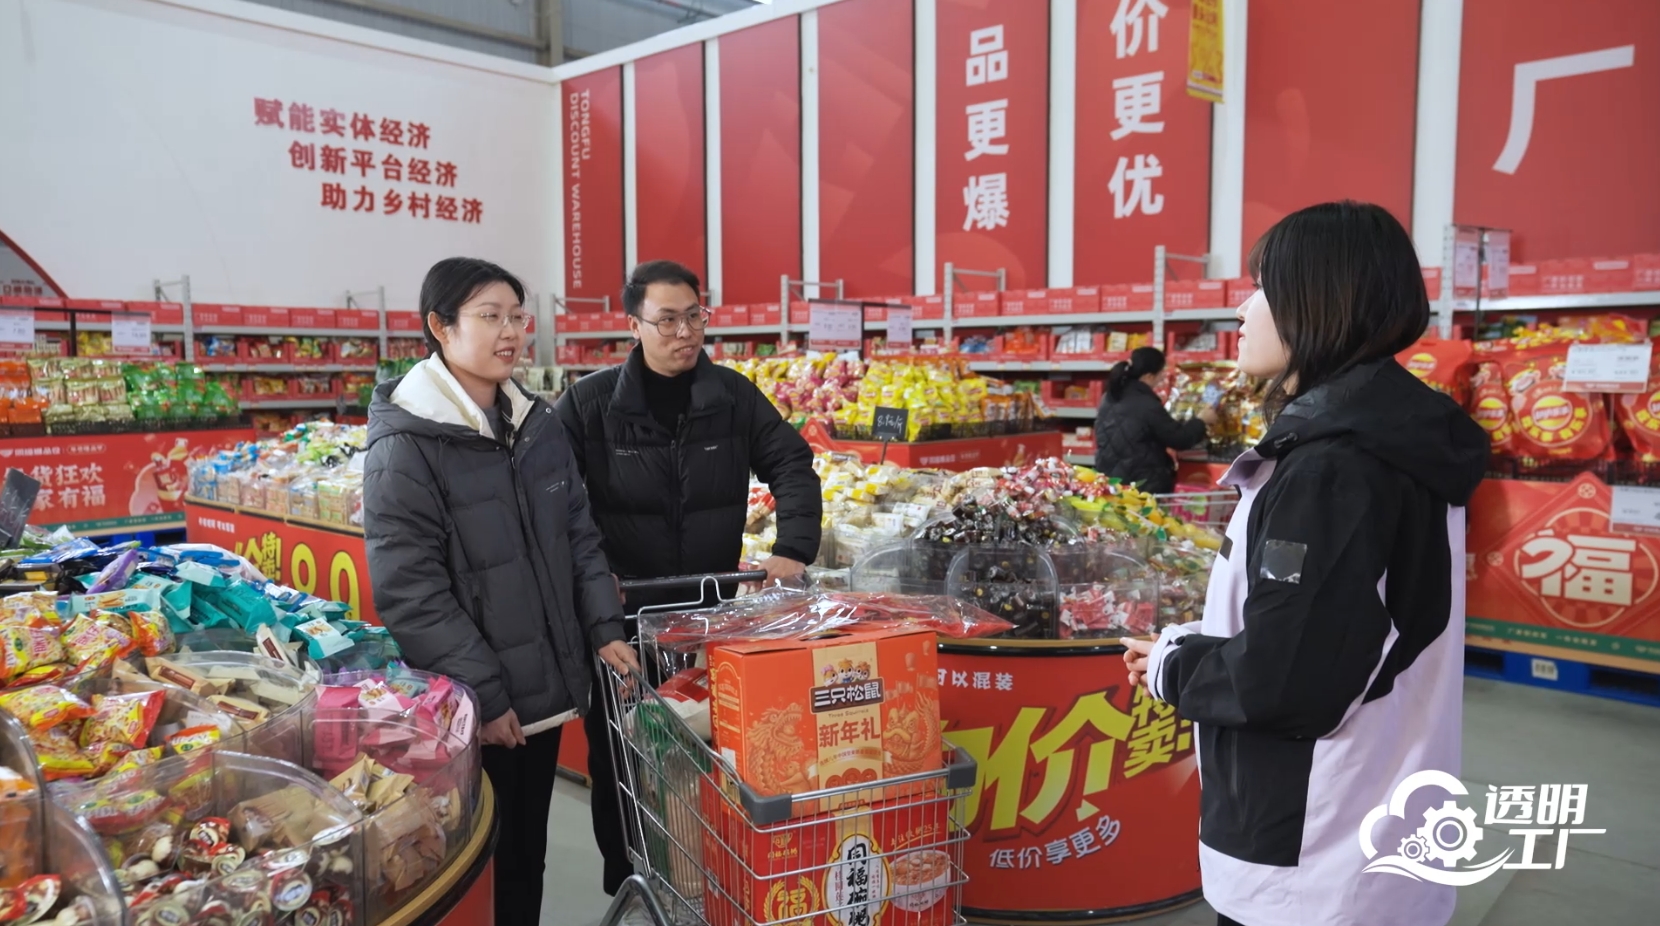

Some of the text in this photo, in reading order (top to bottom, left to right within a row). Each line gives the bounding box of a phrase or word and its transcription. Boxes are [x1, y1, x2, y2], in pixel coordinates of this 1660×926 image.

[254, 97, 431, 149] 赋能实体经济
[580, 89, 590, 160] TONGFU
[963, 24, 1010, 231] 品更爆
[1107, 0, 1169, 219] 价更优
[1491, 44, 1635, 175] 厂
[288, 140, 458, 188] 创新平台经济
[321, 182, 483, 224] 助力乡村经济
[570, 93, 582, 289] DISCOUNT WAREHOUSE
[4, 462, 104, 487] 货狂欢
[1521, 528, 1636, 606] 福
[814, 682, 881, 707] 三只松鼠
[819, 716, 881, 748] 新年礼
[989, 815, 1121, 869] 低价享更多
[777, 887, 808, 921] 福
